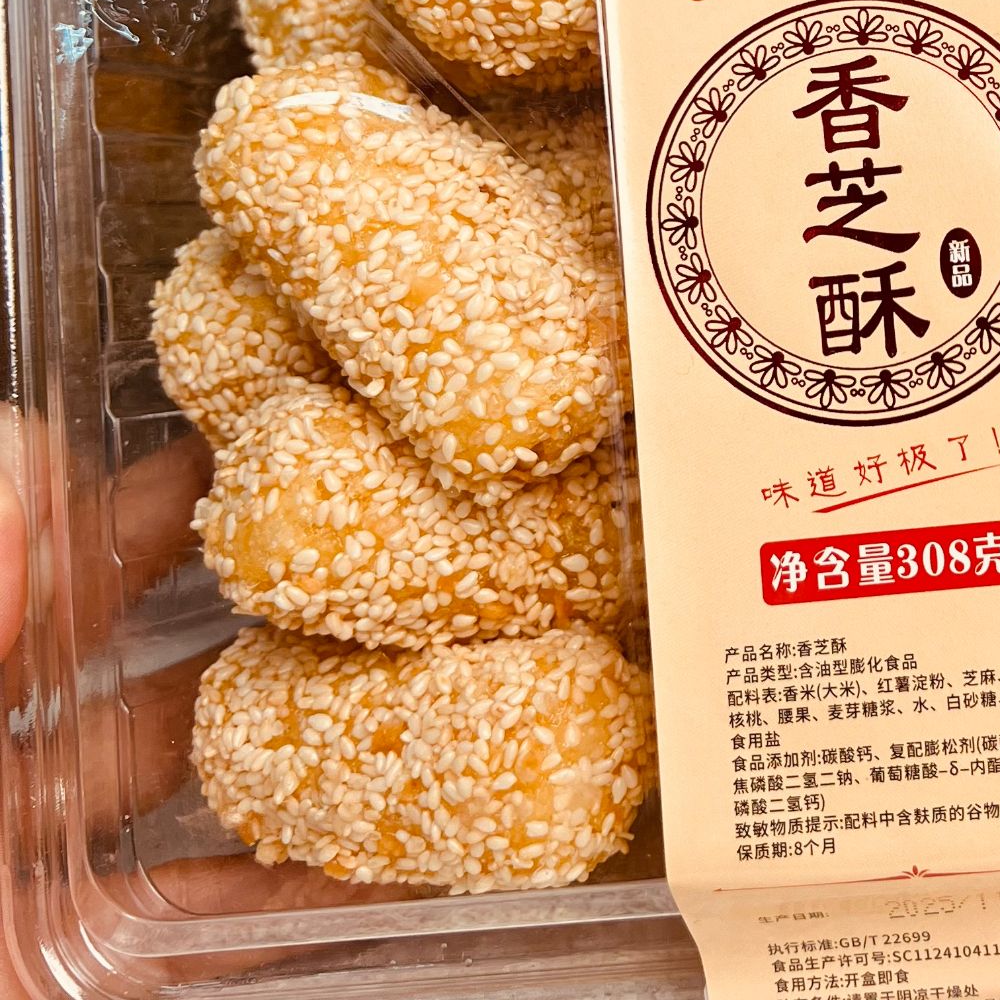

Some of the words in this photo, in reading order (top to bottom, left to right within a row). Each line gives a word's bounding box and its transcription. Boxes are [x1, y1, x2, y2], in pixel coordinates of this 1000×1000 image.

[792, 55, 931, 358] 香芝酥
[948, 239, 973, 289] 新品
[725, 637, 848, 664] 产品名称:香芝酥
[726, 653, 918, 686] 产品类型:含油型膨化食品
[731, 731, 781, 750] 食用盐
[734, 793, 825, 817] 磷酸二氢钙)
[737, 837, 836, 861] 保质期:8个月
[758, 911, 830, 924] 生产日期:
[774, 968, 909, 993] 食用方法:开盒即食
